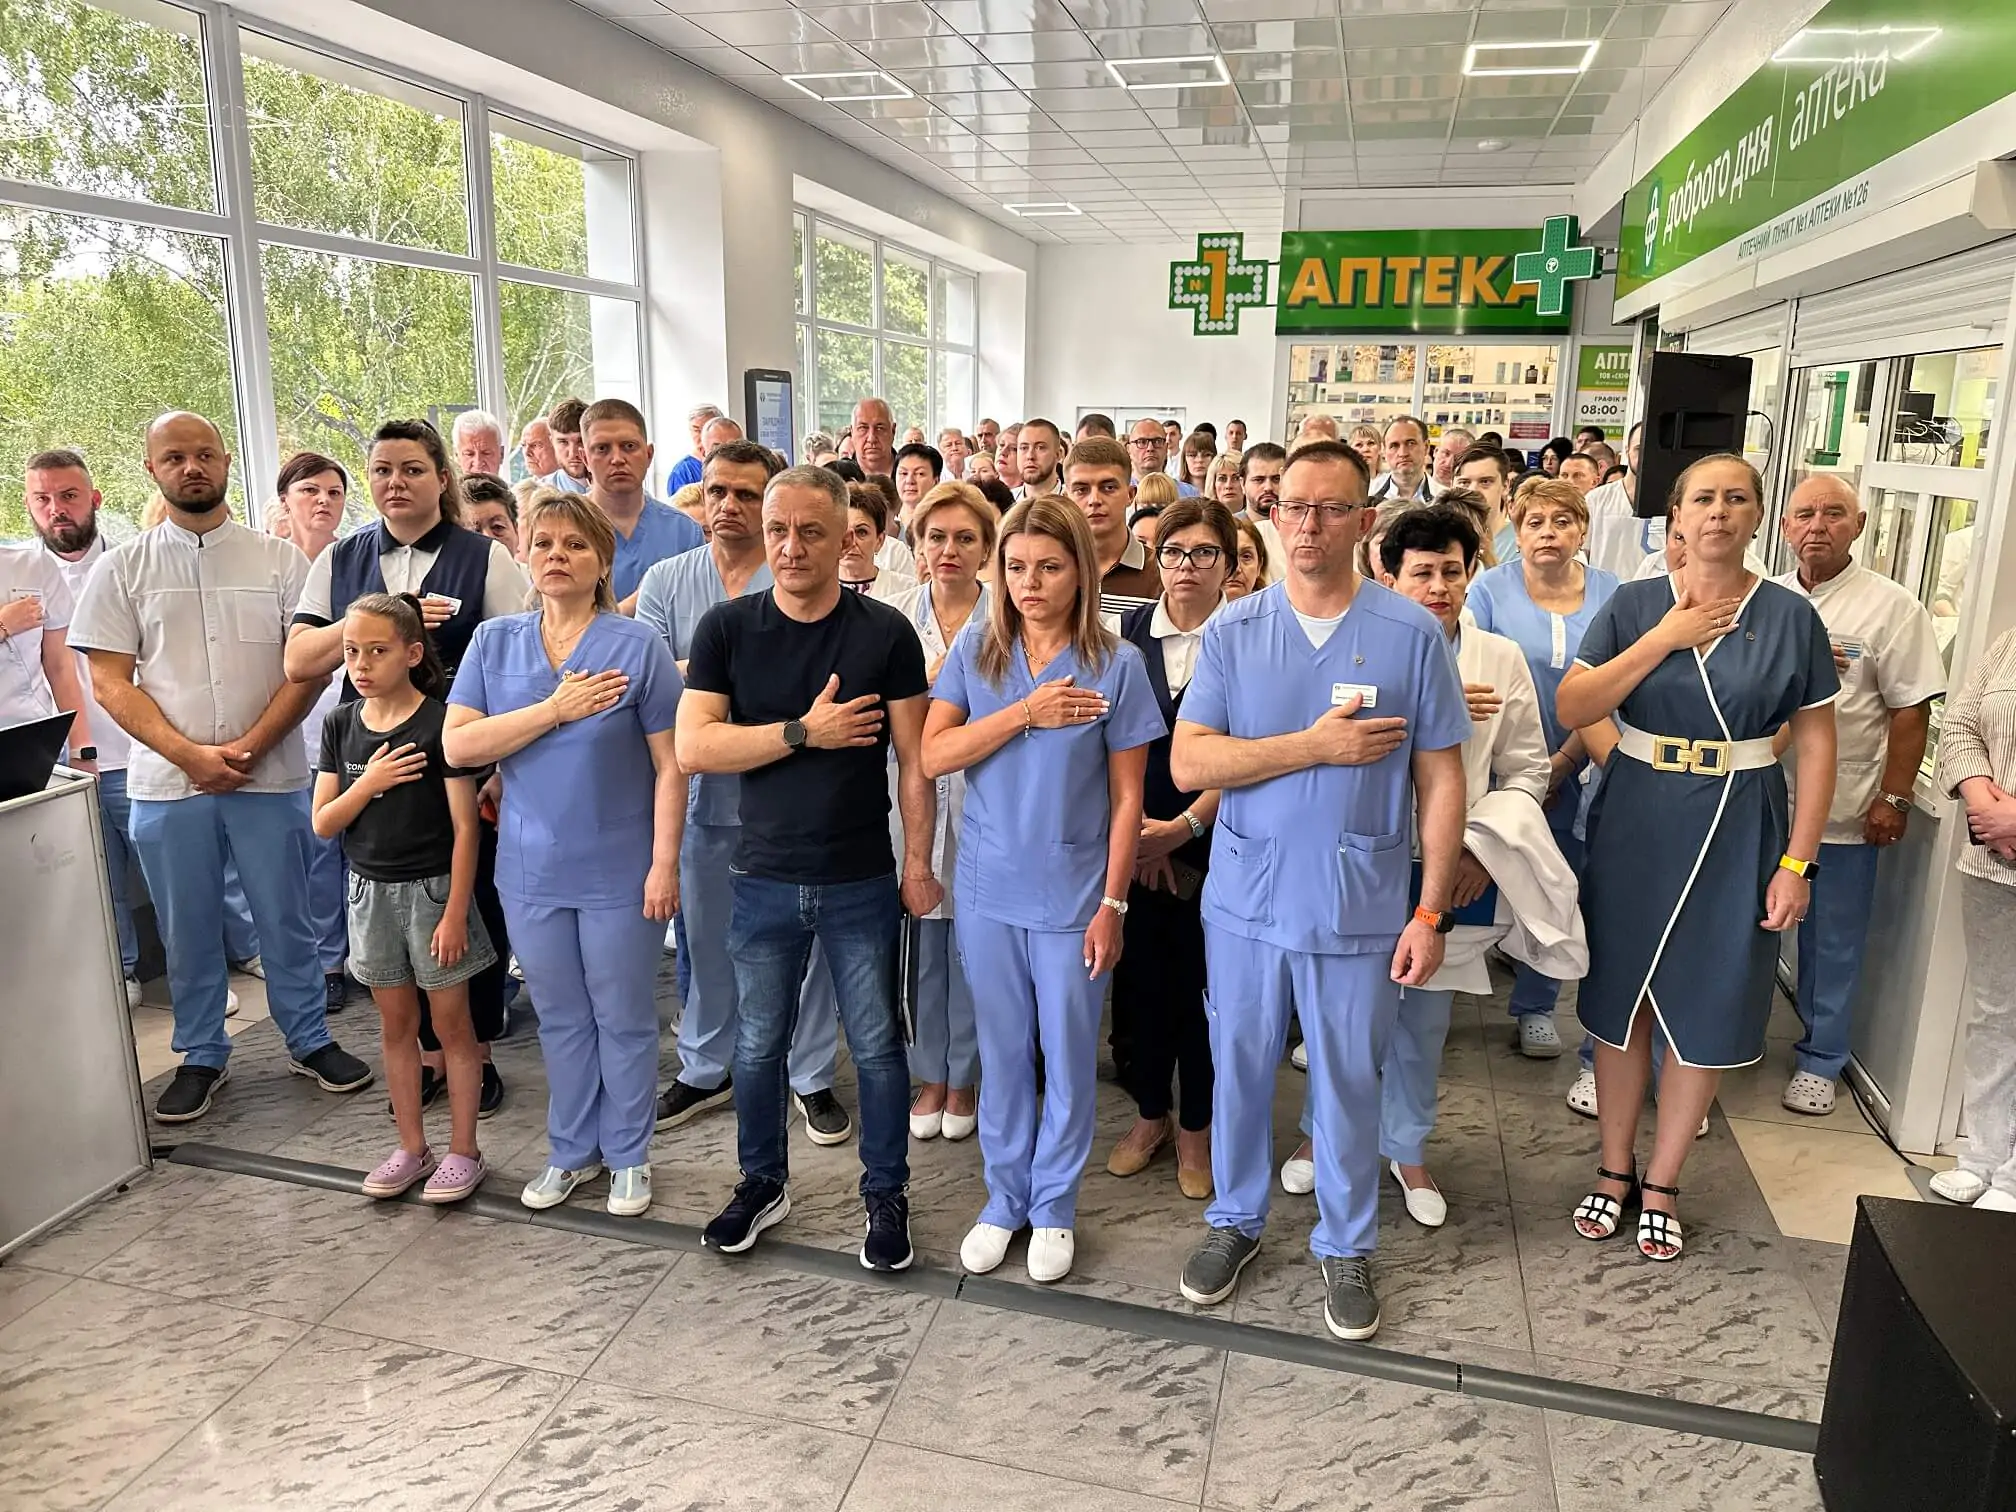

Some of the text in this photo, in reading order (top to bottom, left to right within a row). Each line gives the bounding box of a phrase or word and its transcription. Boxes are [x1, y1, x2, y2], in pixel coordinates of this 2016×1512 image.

[1662, 45, 1889, 247] доброго дня аптека
[1737, 225, 1772, 260] АПТЕЧНИЙ
[1771, 216, 1796, 246] ПУНКТ
[1808, 193, 1842, 229] АПТЕКИ
[1841, 180, 1870, 213] №126
[1594, 352, 1632, 370] АПТ
[1581, 405, 1618, 415] 08:00
